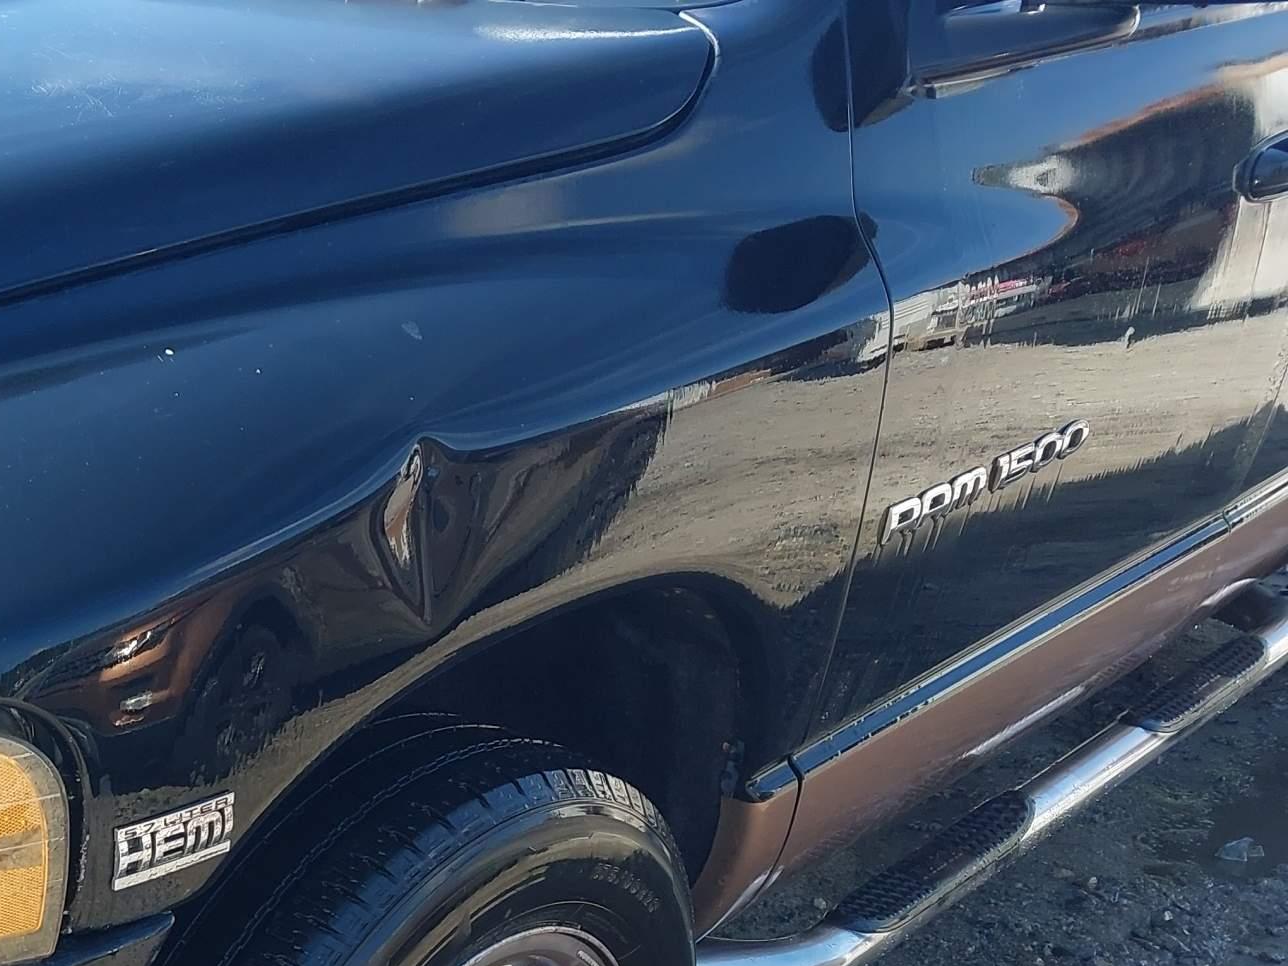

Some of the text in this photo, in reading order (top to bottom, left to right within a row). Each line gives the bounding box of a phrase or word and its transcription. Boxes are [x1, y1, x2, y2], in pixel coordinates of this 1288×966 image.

[879, 419, 1090, 545] RAM 1500
[116, 804, 234, 878] HEMI
[164, 797, 229, 828] LITER
